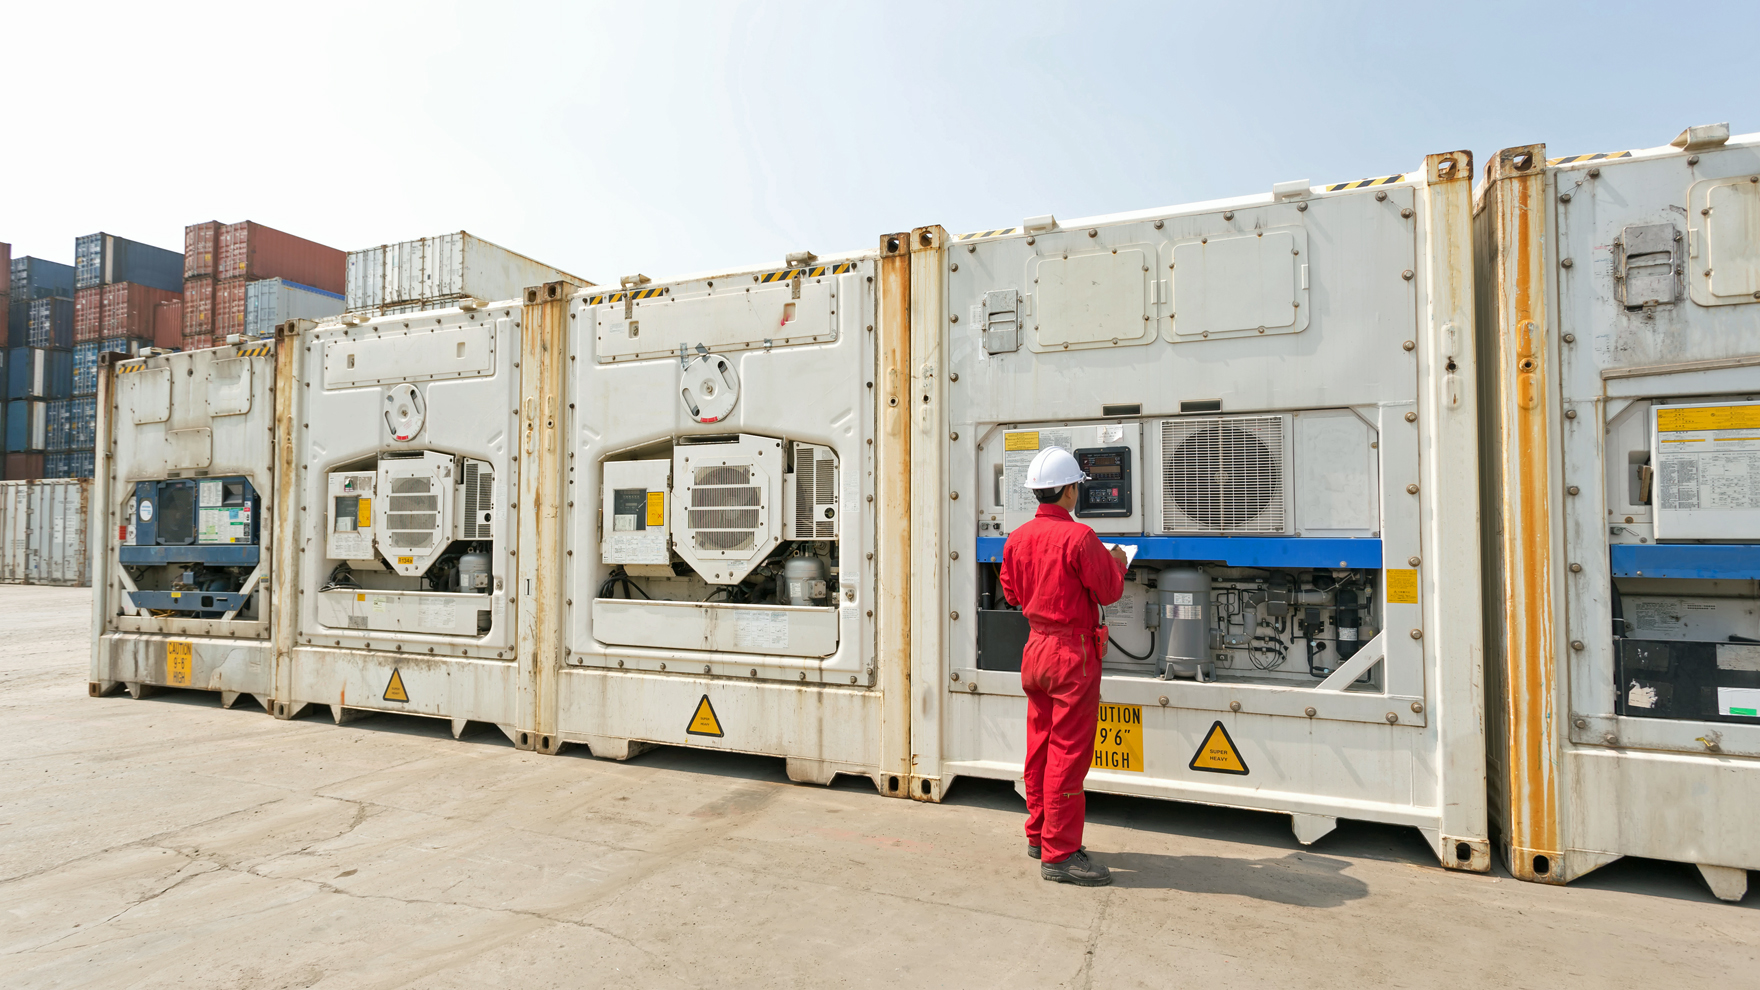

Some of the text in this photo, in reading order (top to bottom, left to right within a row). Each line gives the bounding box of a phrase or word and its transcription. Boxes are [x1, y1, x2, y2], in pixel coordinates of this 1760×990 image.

[168, 642, 192, 656] CAUTION
[173, 671, 186, 683] HIGH
[1098, 705, 1141, 725] UTION
[1095, 750, 1130, 769] HIGH
